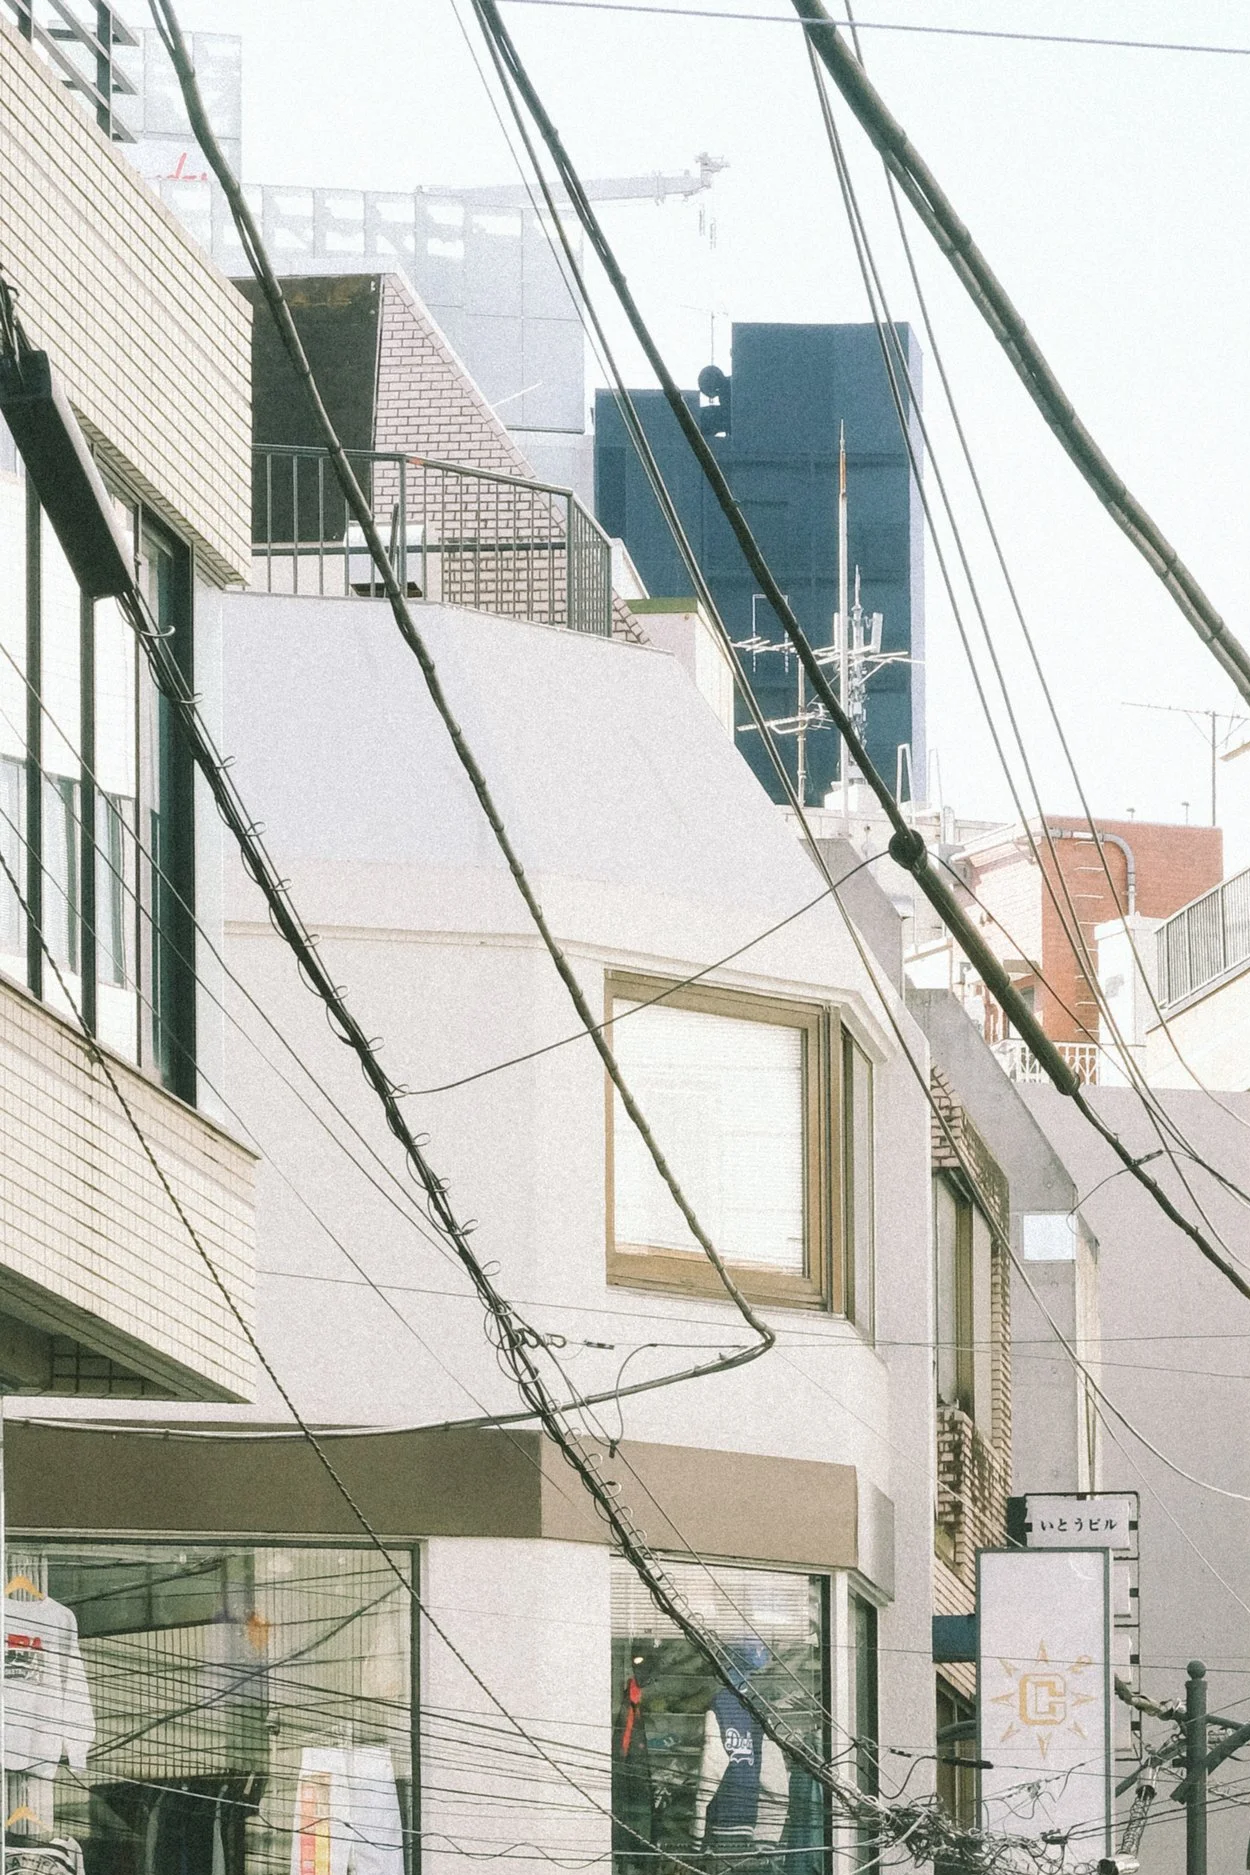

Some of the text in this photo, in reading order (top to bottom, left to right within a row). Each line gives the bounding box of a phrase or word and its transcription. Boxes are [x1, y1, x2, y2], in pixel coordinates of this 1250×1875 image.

[1040, 1518, 1117, 1532] いとうビル
